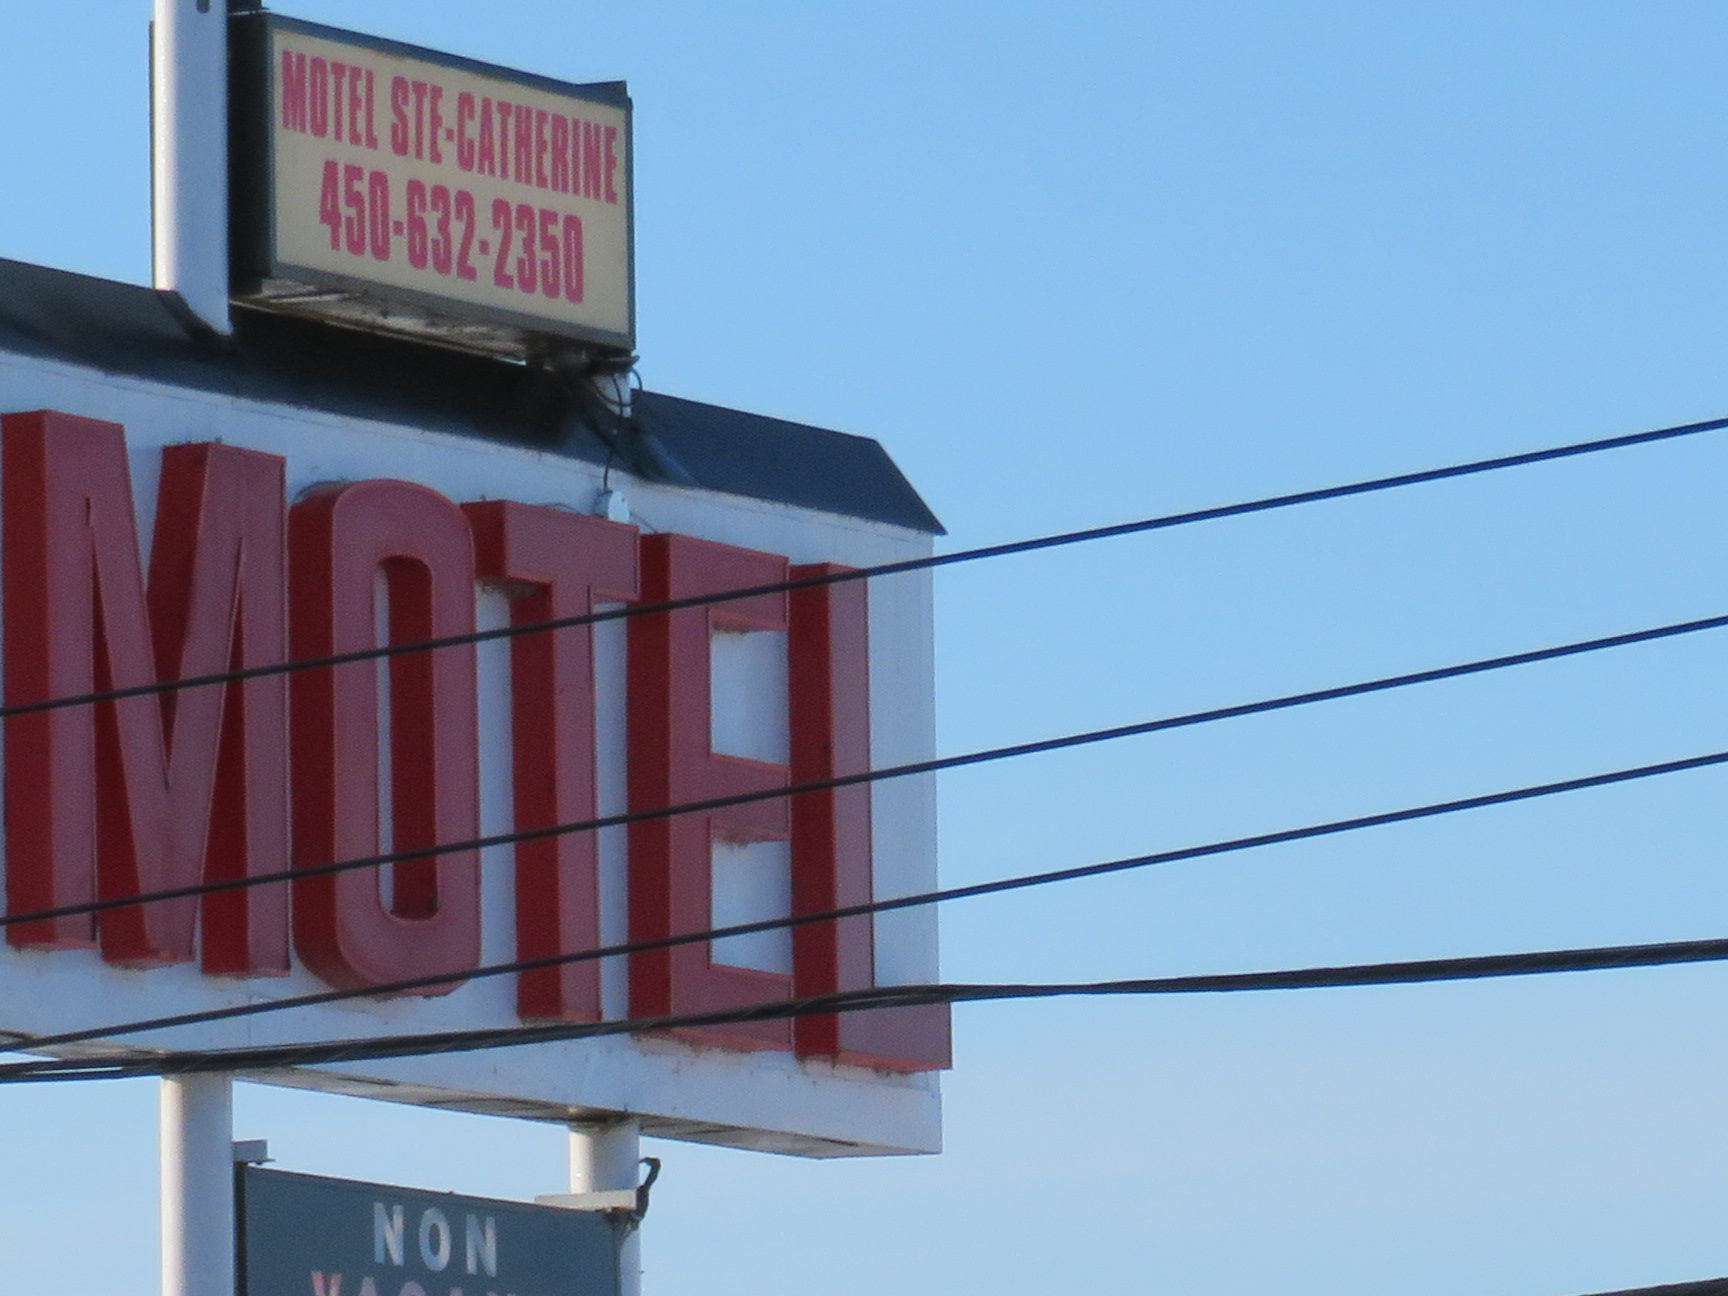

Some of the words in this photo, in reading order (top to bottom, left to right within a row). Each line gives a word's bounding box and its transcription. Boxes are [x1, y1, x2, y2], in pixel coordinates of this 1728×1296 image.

[281, 48, 378, 151] MOTEL
[390, 75, 618, 205] STE-CATHERINE
[319, 159, 585, 305] 450-632-2350
[0, 408, 953, 1071] MOTEL
[372, 1202, 497, 1278] NON
